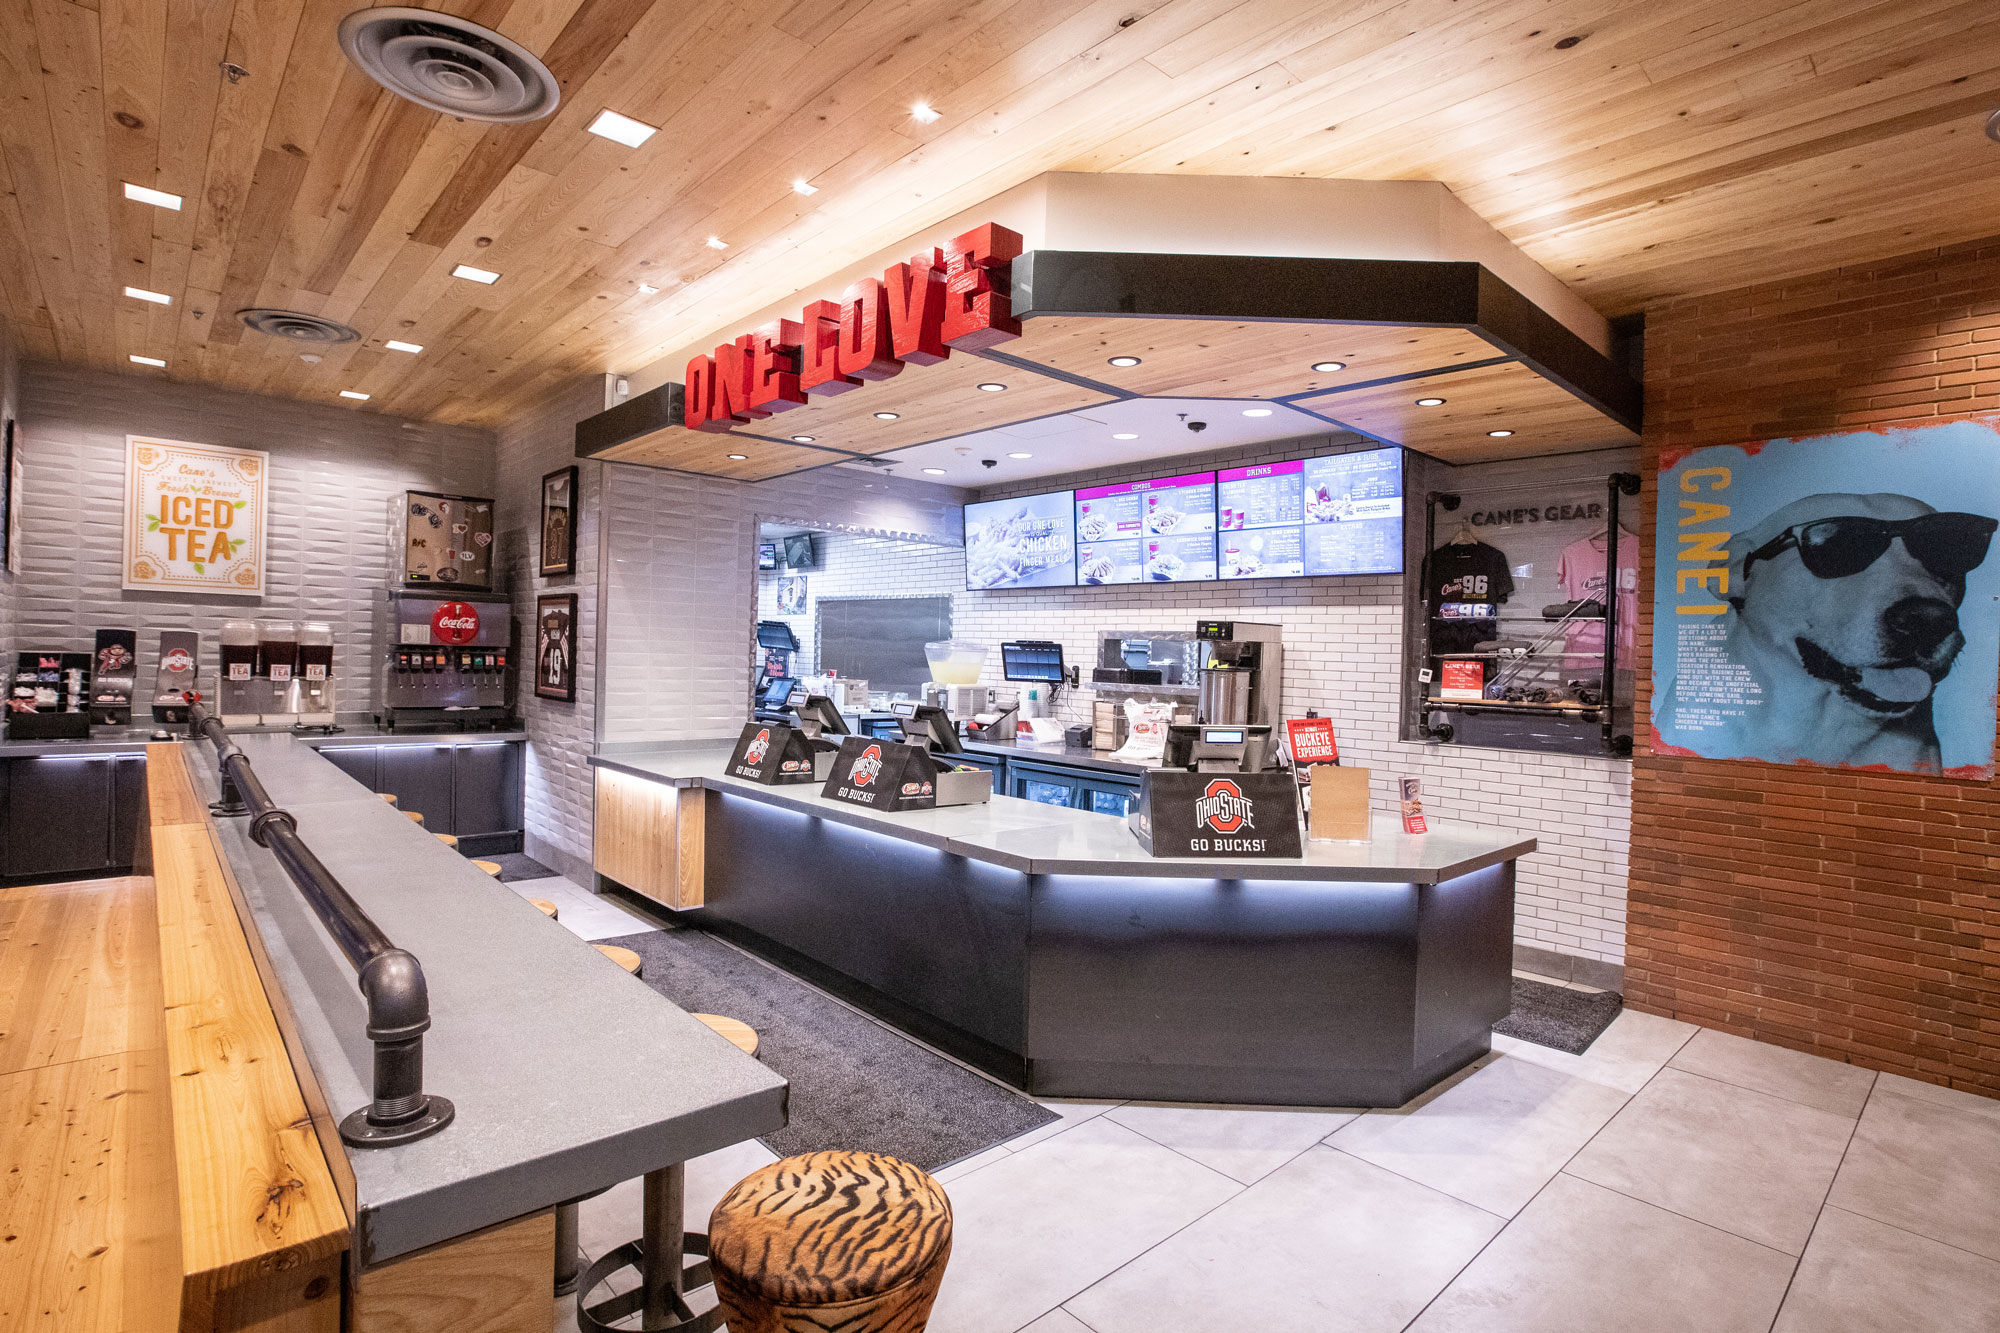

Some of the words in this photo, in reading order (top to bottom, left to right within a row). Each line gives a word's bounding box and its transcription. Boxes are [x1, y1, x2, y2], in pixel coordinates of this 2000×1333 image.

[684, 318, 806, 432] ONE
[800, 222, 1023, 397] LOVE
[179, 463, 216, 478] Cane's
[1246, 467, 1272, 477] DRINKS
[156, 481, 190, 494] Fresh
[202, 485, 242, 498] Brewed
[160, 494, 234, 529] ICED
[1471, 508, 1540, 527] CANE'S
[1544, 503, 1601, 521] GEAR
[1019, 521, 1031, 532] OUR
[1032, 520, 1045, 530] ONE
[1047, 518, 1065, 529] LOVE
[159, 527, 232, 564] TEA
[1020, 535, 1067, 553] CHICKEN
[461, 552, 474, 560] 1LV
[1020, 556, 1043, 567] FINGER
[1441, 583, 1464, 596] Cane's
[1463, 575, 1488, 594] 96
[1459, 603, 1488, 618] 96
[439, 616, 476, 629] Coca-Cola
[232, 667, 249, 675] TEA
[309, 668, 324, 676] TEA
[549, 648, 561, 685] 19
[1294, 731, 1331, 747] BUCKEYE
[1297, 745, 1333, 758] EXPERIENCE
[735, 765, 744, 775] GO
[742, 766, 762, 779] BUCKS!
[838, 787, 849, 798] GO
[848, 789, 876, 803] BUCKS!
[1190, 838, 1209, 851] GO
[1213, 838, 1266, 852] BUCKS!
